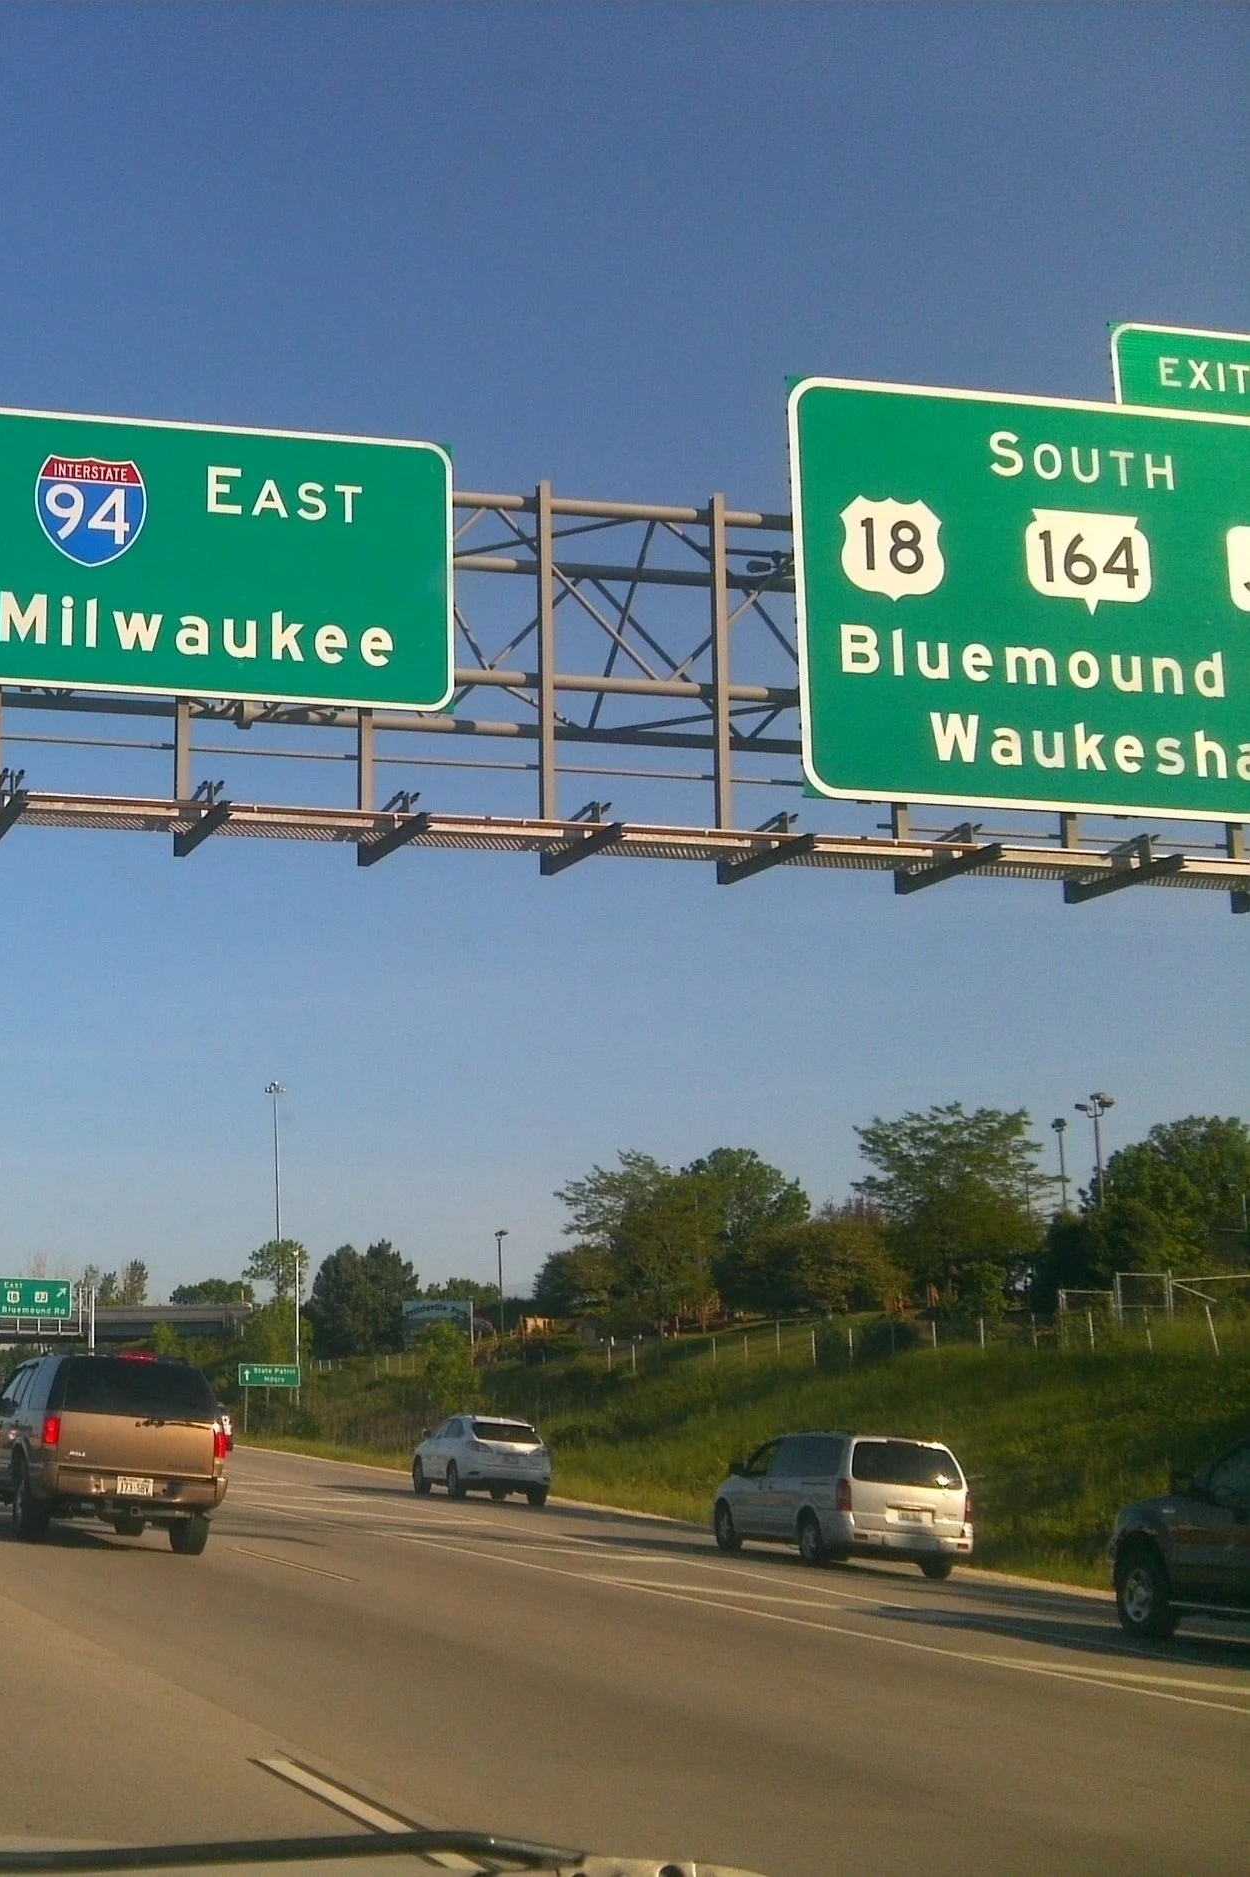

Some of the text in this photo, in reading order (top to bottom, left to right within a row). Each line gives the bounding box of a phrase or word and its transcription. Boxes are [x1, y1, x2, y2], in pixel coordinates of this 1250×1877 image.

[1159, 356, 1250, 395] EXIT
[53, 462, 128, 481] INTERSTATE
[989, 431, 1175, 491] SOUTH
[45, 483, 130, 545] 94
[207, 466, 363, 523] EAST
[860, 517, 925, 575] 18
[1038, 529, 1140, 589] 164
[840, 623, 1225, 699] Bluemound
[1, 1305, 66, 1315] Bluemound Rd
[3, 1281, 23, 1289] EAST
[9, 1292, 18, 1301] 18
